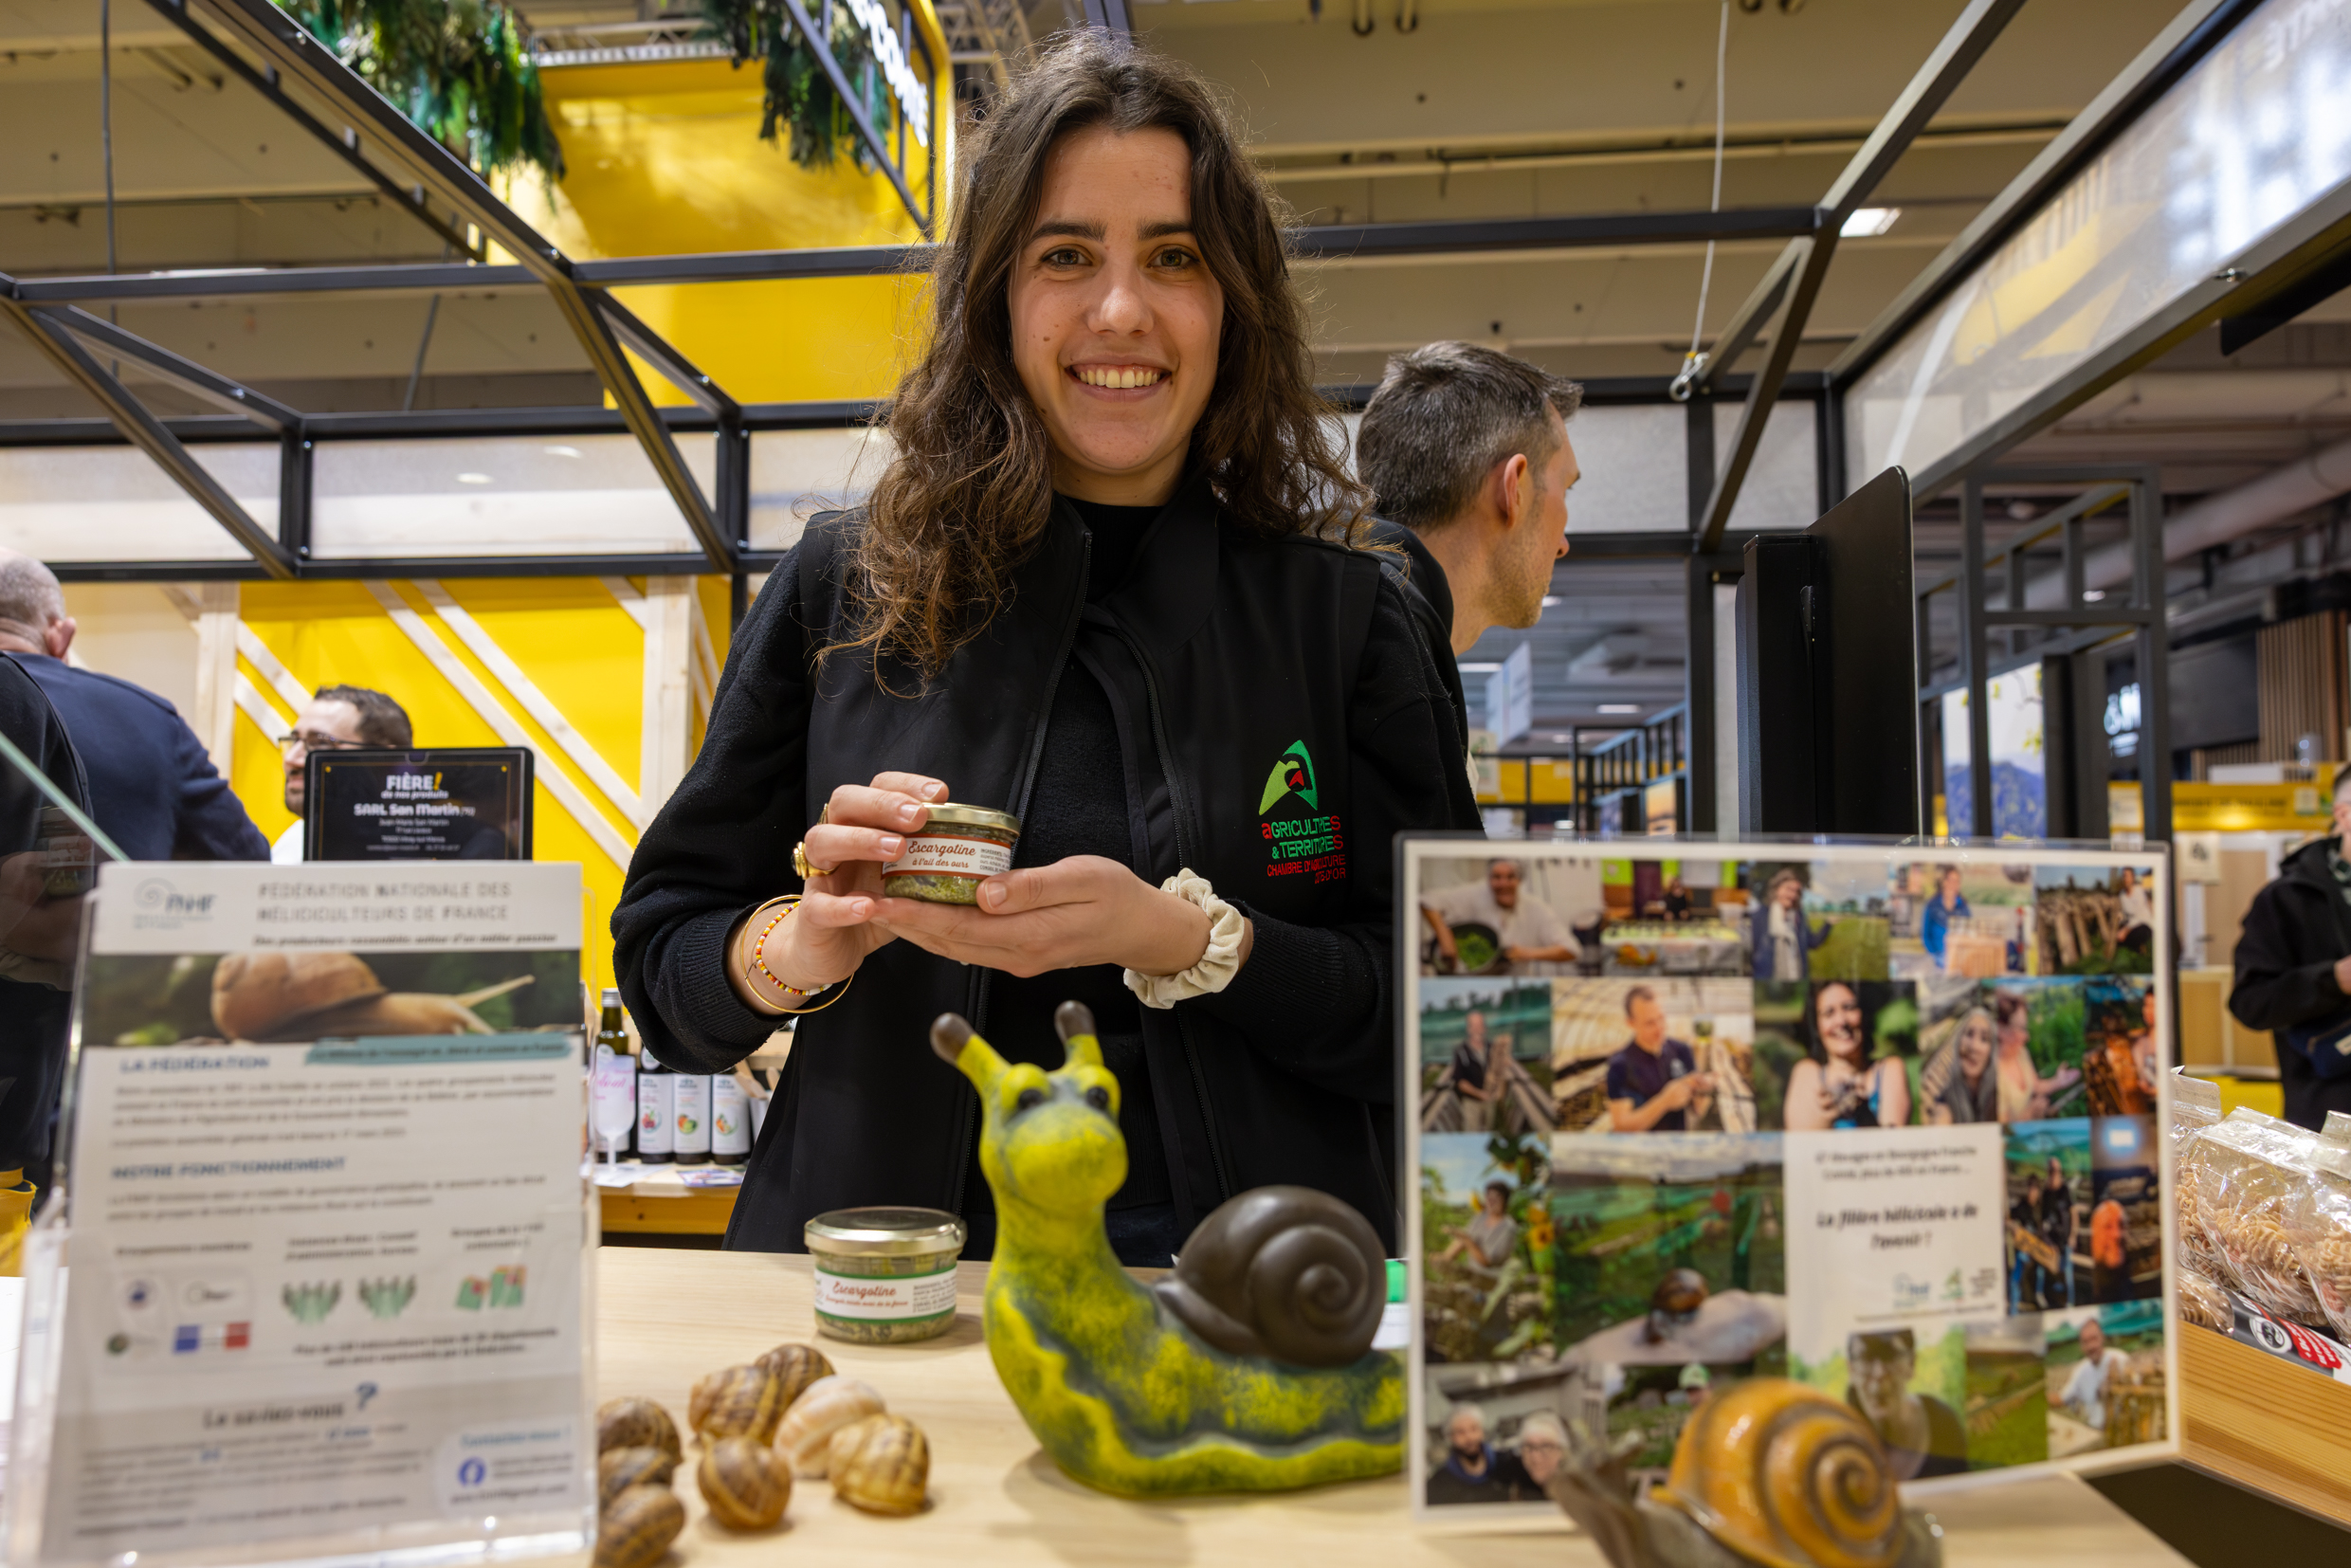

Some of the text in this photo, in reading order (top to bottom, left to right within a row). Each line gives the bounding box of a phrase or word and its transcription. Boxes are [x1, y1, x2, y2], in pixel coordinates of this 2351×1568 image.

[410, 790, 448, 801] produits
[415, 802, 460, 816] Martin
[908, 840, 976, 858] Escargotine
[1271, 846, 1280, 860] &
[912, 857, 969, 868] à l'ail des ours
[1267, 861, 1303, 877] CHAMBRE
[832, 1280, 897, 1300] Escargotine
